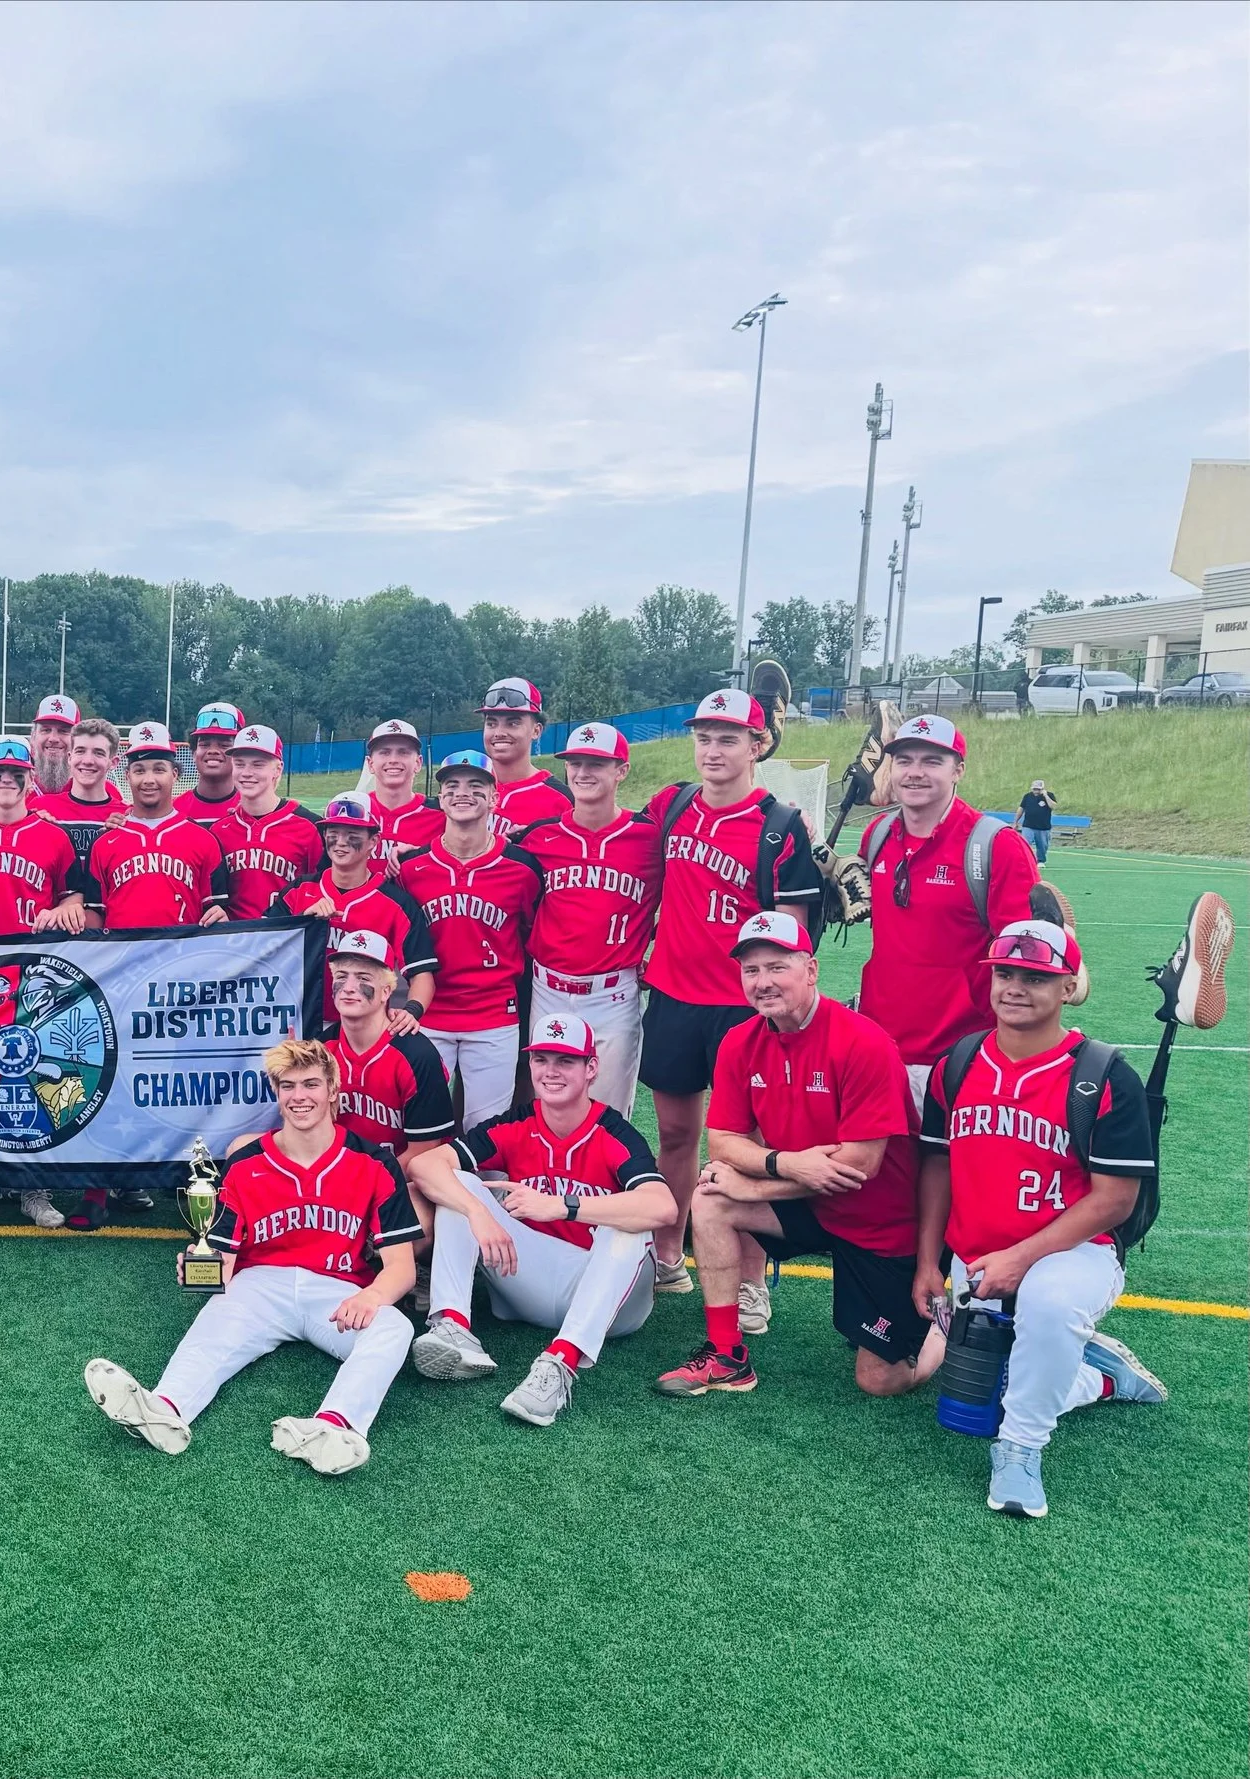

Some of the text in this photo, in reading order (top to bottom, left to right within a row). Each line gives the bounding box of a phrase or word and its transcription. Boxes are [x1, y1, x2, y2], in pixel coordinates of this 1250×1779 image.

[112, 852, 194, 891] HERNDON
[934, 865, 949, 879] H
[972, 843, 985, 881] marucci
[925, 878, 956, 886] BASEBALL
[16, 897, 37, 927] 10
[175, 893, 187, 922] 7
[706, 889, 739, 924] 16
[606, 913, 629, 945] 11
[40, 956, 84, 982] WAKEFIELD
[482, 940, 498, 968] 3
[147, 975, 280, 1008] LIBERTY
[96, 999, 115, 1050] YORKTOWN
[131, 1005, 296, 1040] DISTRICT
[806, 1085, 831, 1093] BASEBALL
[813, 1071, 824, 1087] H
[75, 1088, 104, 1126] LANGLEY
[1018, 1170, 1066, 1212] 24
[253, 1204, 363, 1245] HERNDON
[861, 1321, 891, 1343] BASEBALL
[874, 1316, 892, 1334] H
